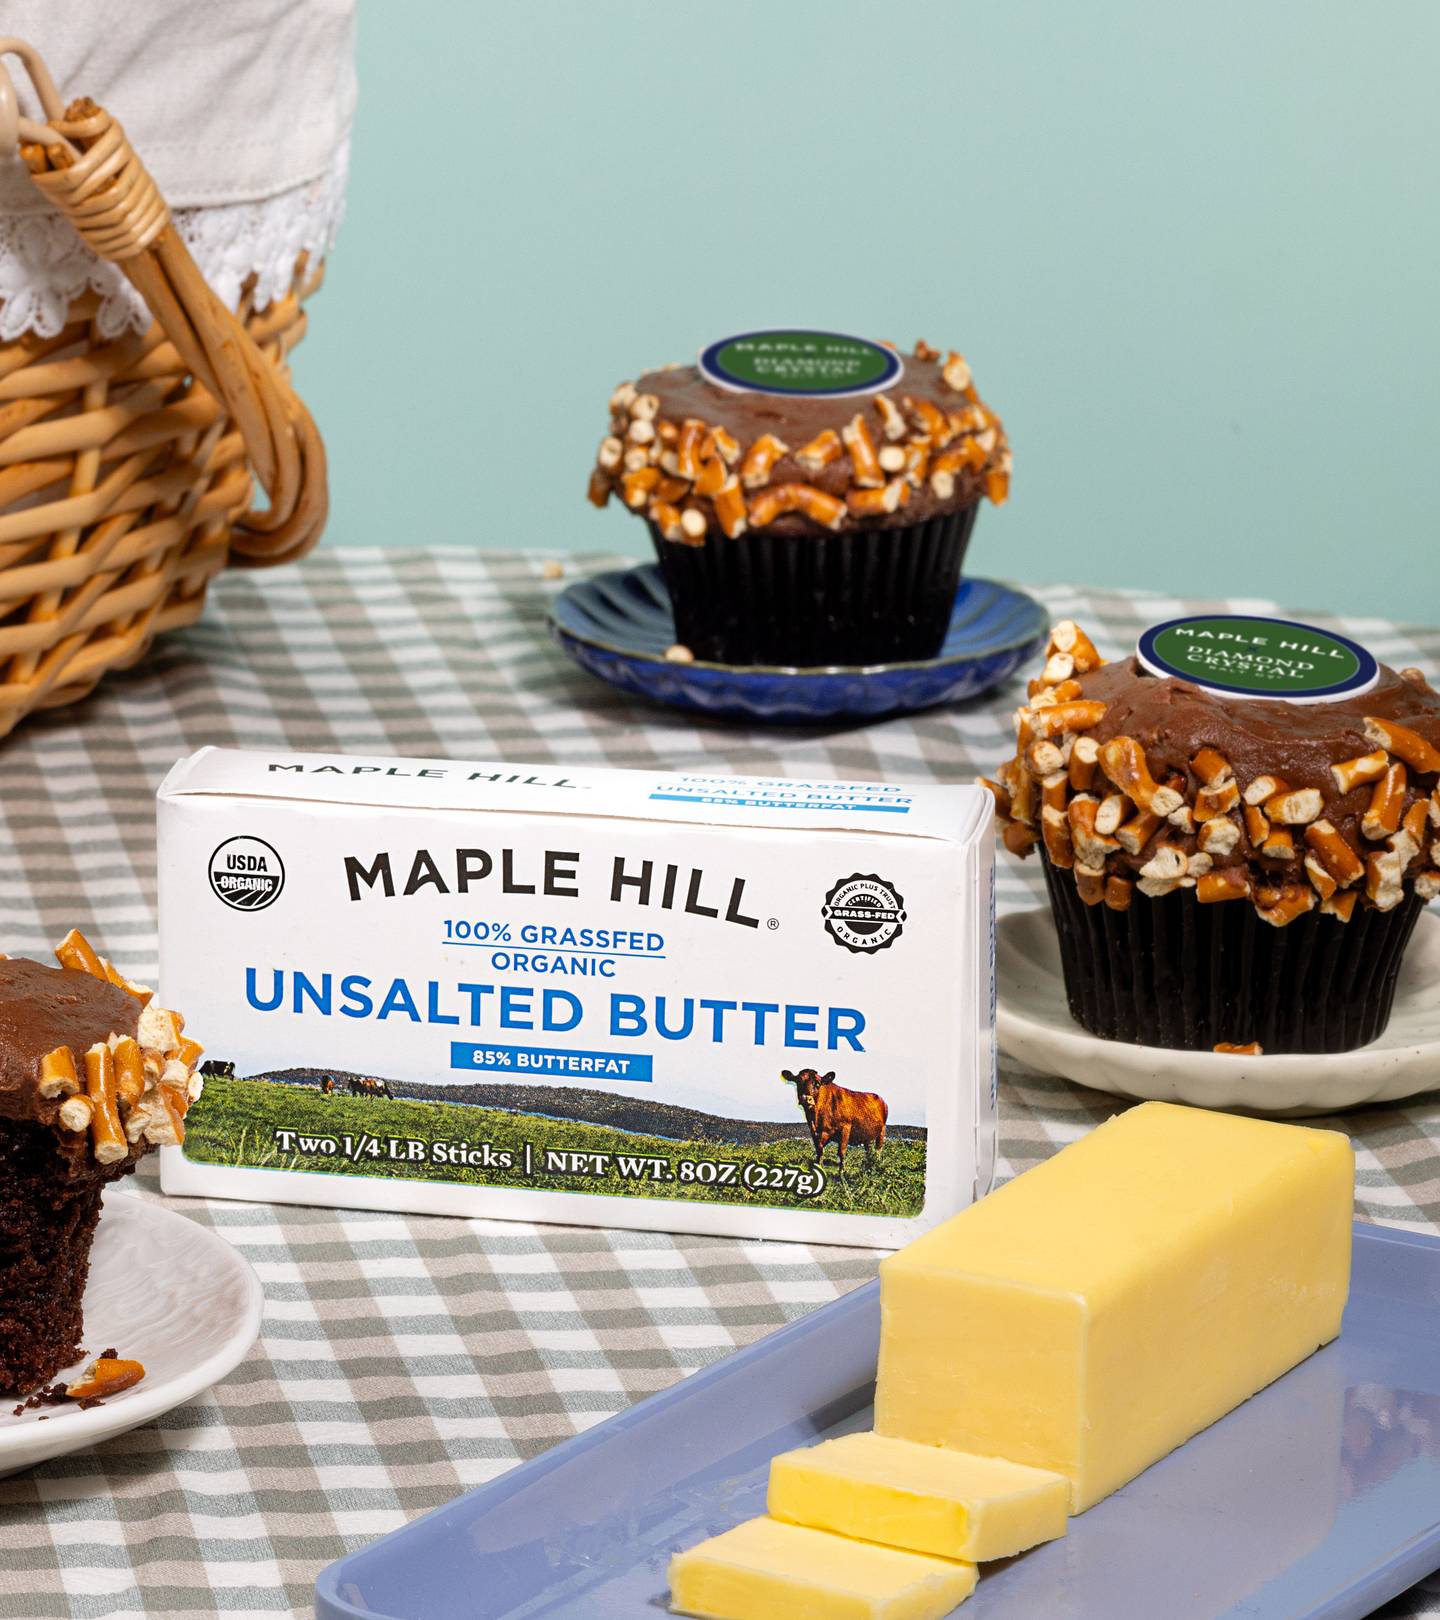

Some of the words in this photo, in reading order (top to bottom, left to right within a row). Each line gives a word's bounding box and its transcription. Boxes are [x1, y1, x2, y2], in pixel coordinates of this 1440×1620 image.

[1175, 629, 1269, 645] MAPLE
[1278, 640, 1346, 659] HILL
[1186, 645, 1316, 671] DIAMOND
[1186, 654, 1305, 680] CRYSTAL
[267, 763, 449, 779] MAPLE
[466, 772, 578, 789] HILL
[679, 776, 748, 786] 100%
[757, 780, 902, 793] GRASSFED
[655, 785, 798, 799] UNSALTED
[806, 793, 913, 805] BUTTER
[744, 798, 857, 811] BUTTERFAT
[226, 853, 268, 873] USDA
[343, 848, 580, 901] MAPLE
[220, 875, 273, 892] ORGANIC
[833, 883, 858, 907] ORGANIC
[859, 882, 879, 892] PLUS
[879, 888, 896, 909] TRUST
[833, 909, 896, 920] GRASS-FED
[442, 919, 513, 943] 100%
[520, 923, 666, 952] GRASSFED
[836, 926, 892, 946] ORGANIC
[490, 952, 617, 978] ORGANIC
[245, 967, 584, 1033] UNSALTED
[609, 992, 868, 1053] BUTTER
[471, 1049, 513, 1067] 85%
[517, 1051, 631, 1075] BUTTERFAT
[276, 1130, 337, 1155] Two
[342, 1134, 381, 1161] 1/4
[389, 1140, 425, 1160] LB
[432, 1143, 512, 1168] Sticks
[546, 1151, 609, 1175] NET
[617, 1155, 674, 1181] WT.
[680, 1162, 737, 1185] 8OZ
[744, 1165, 825, 1195] (227g)
